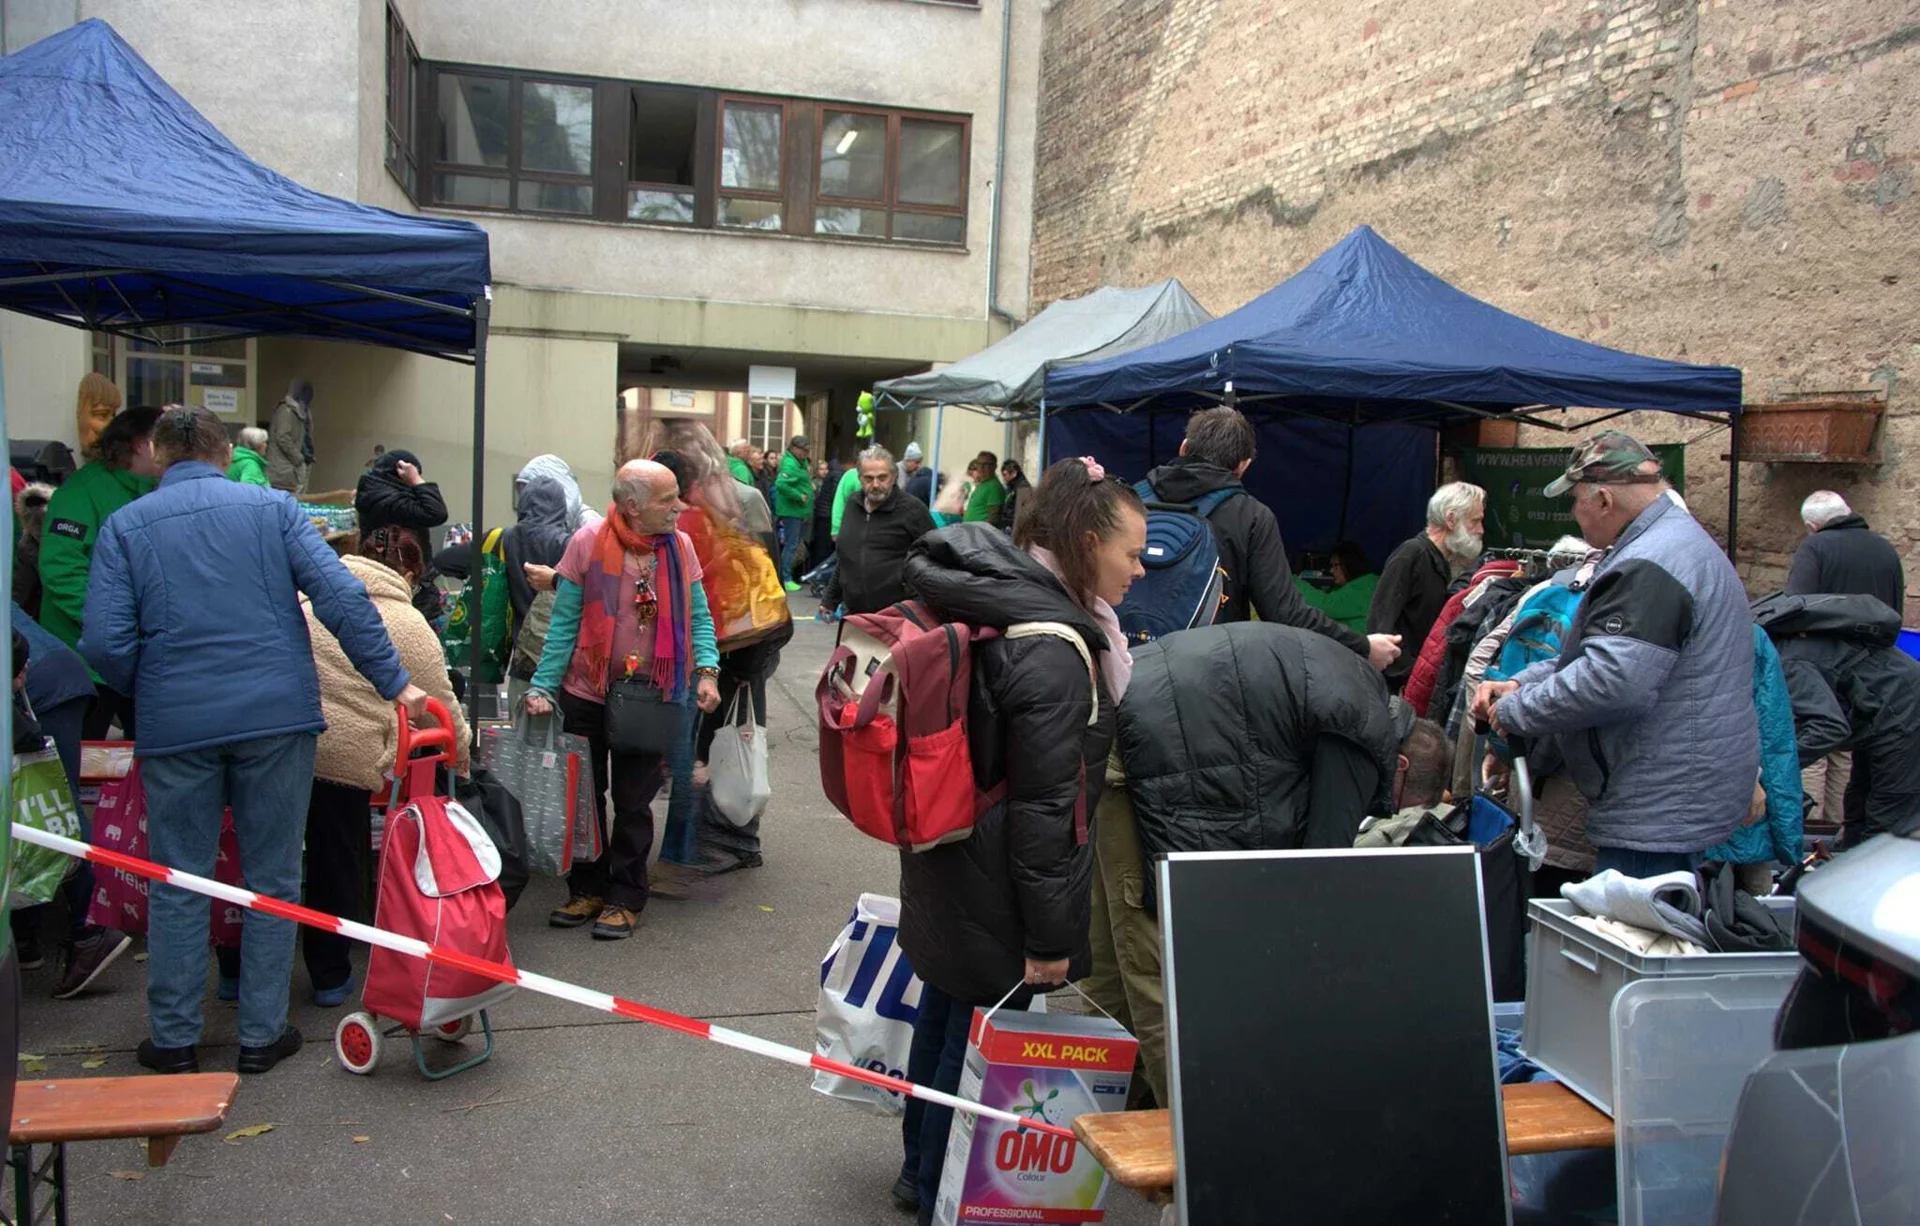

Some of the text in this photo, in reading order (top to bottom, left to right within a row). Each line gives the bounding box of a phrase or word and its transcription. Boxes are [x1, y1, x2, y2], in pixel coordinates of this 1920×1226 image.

[57, 523, 80, 535] ORGA
[20, 789, 71, 822] I'LL
[1021, 1042, 1109, 1063] XXL PACK
[995, 1130, 1076, 1174] OMO
[1017, 1173, 1046, 1181] Colour
[965, 1206, 1044, 1220] PROFESSIONAL
